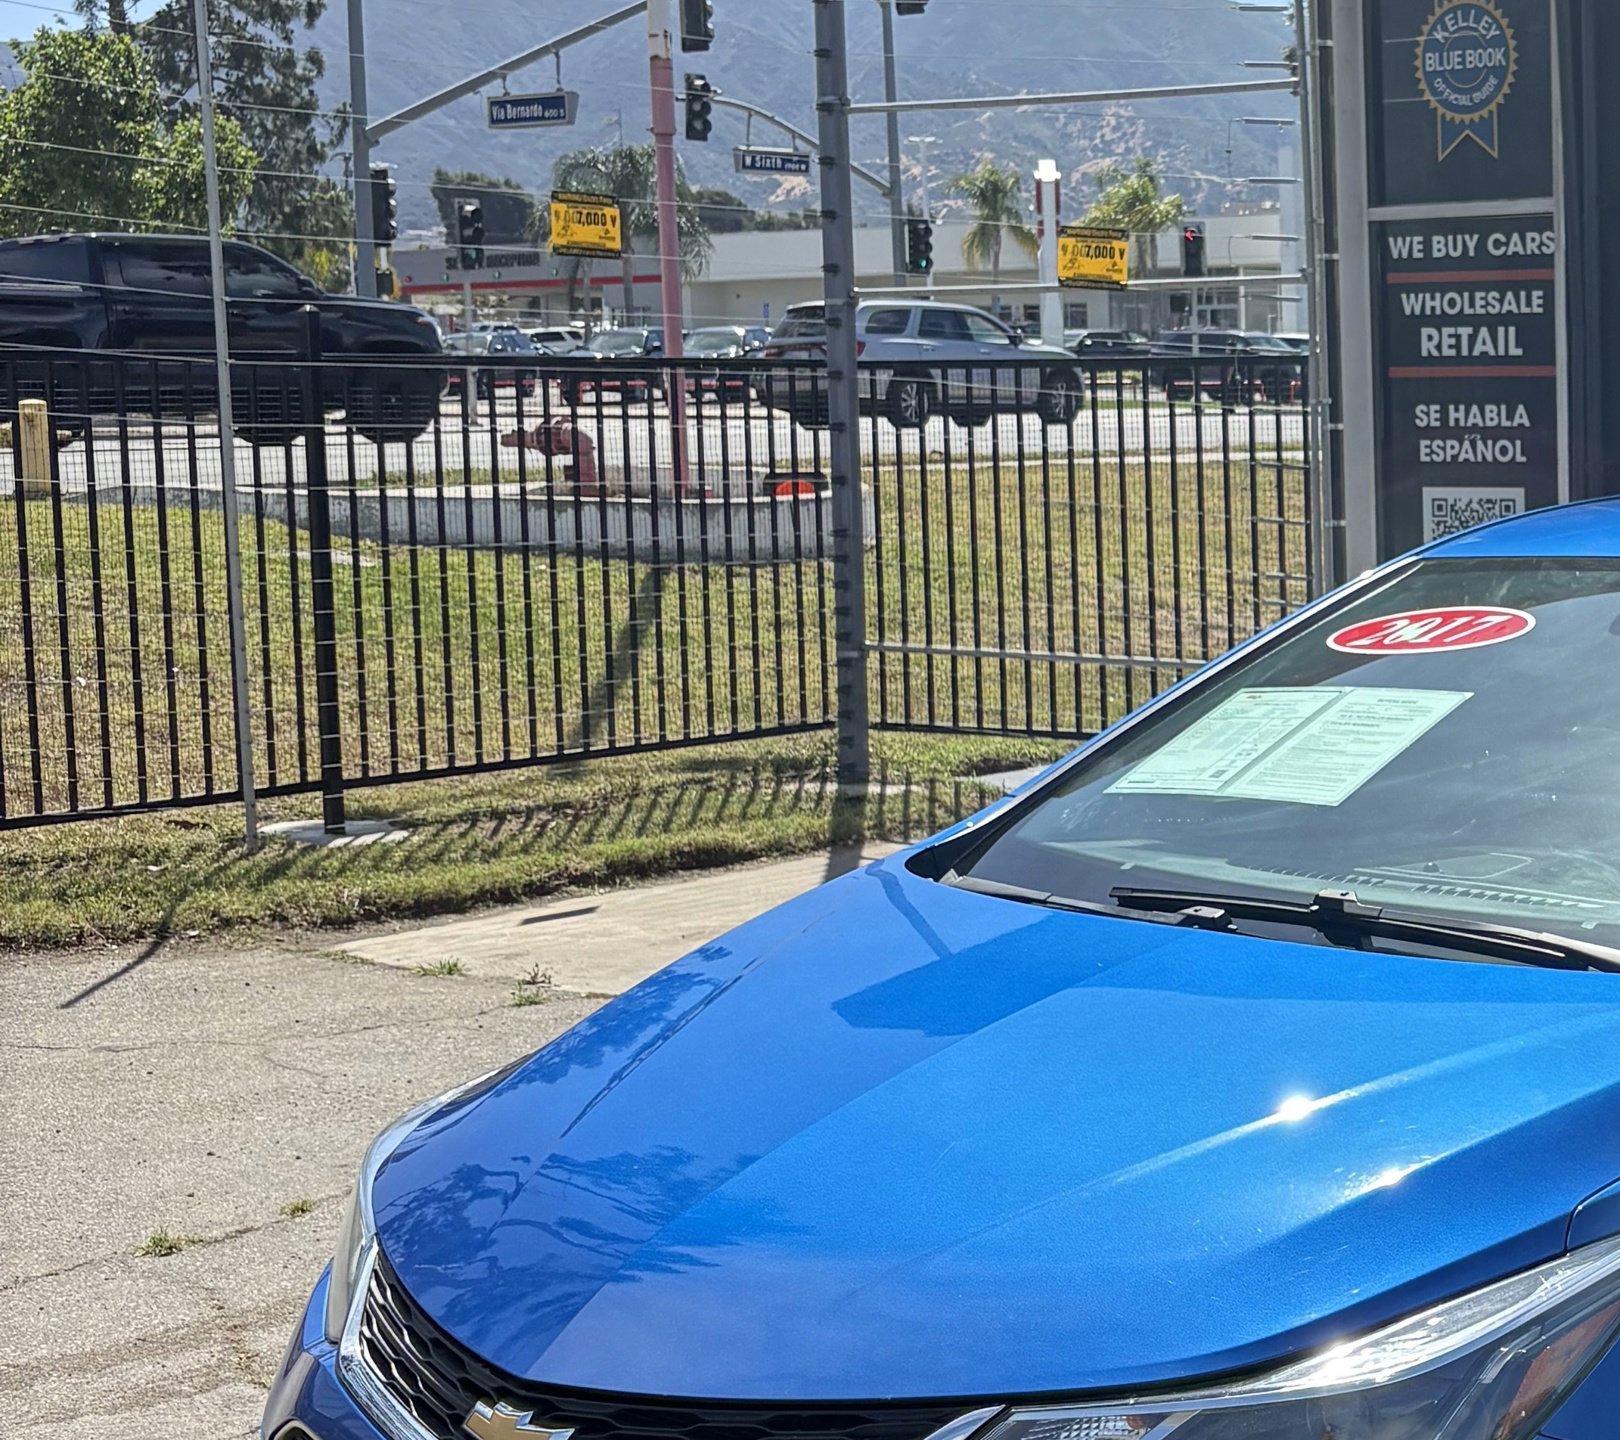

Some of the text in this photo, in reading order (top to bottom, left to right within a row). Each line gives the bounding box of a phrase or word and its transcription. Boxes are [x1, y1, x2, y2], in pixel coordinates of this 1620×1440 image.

[1432, 9, 1501, 43] KELLEY
[1425, 47, 1507, 72] BLUE BOOK
[1433, 75, 1499, 106] OFFICIAL GUIDE
[492, 105, 505, 120] Via
[506, 103, 543, 120] Bernardo
[744, 155, 752, 167] W
[755, 154, 782, 169] Sixth
[1388, 231, 1555, 259] WE BUY CARS
[1401, 290, 1544, 316] WHOLESALE
[1421, 326, 1523, 357] RETAIL
[1414, 404, 1531, 428] SE HABLA
[1419, 433, 1527, 463] ESPAÑOL
[1345, 615, 1514, 647] 2017
